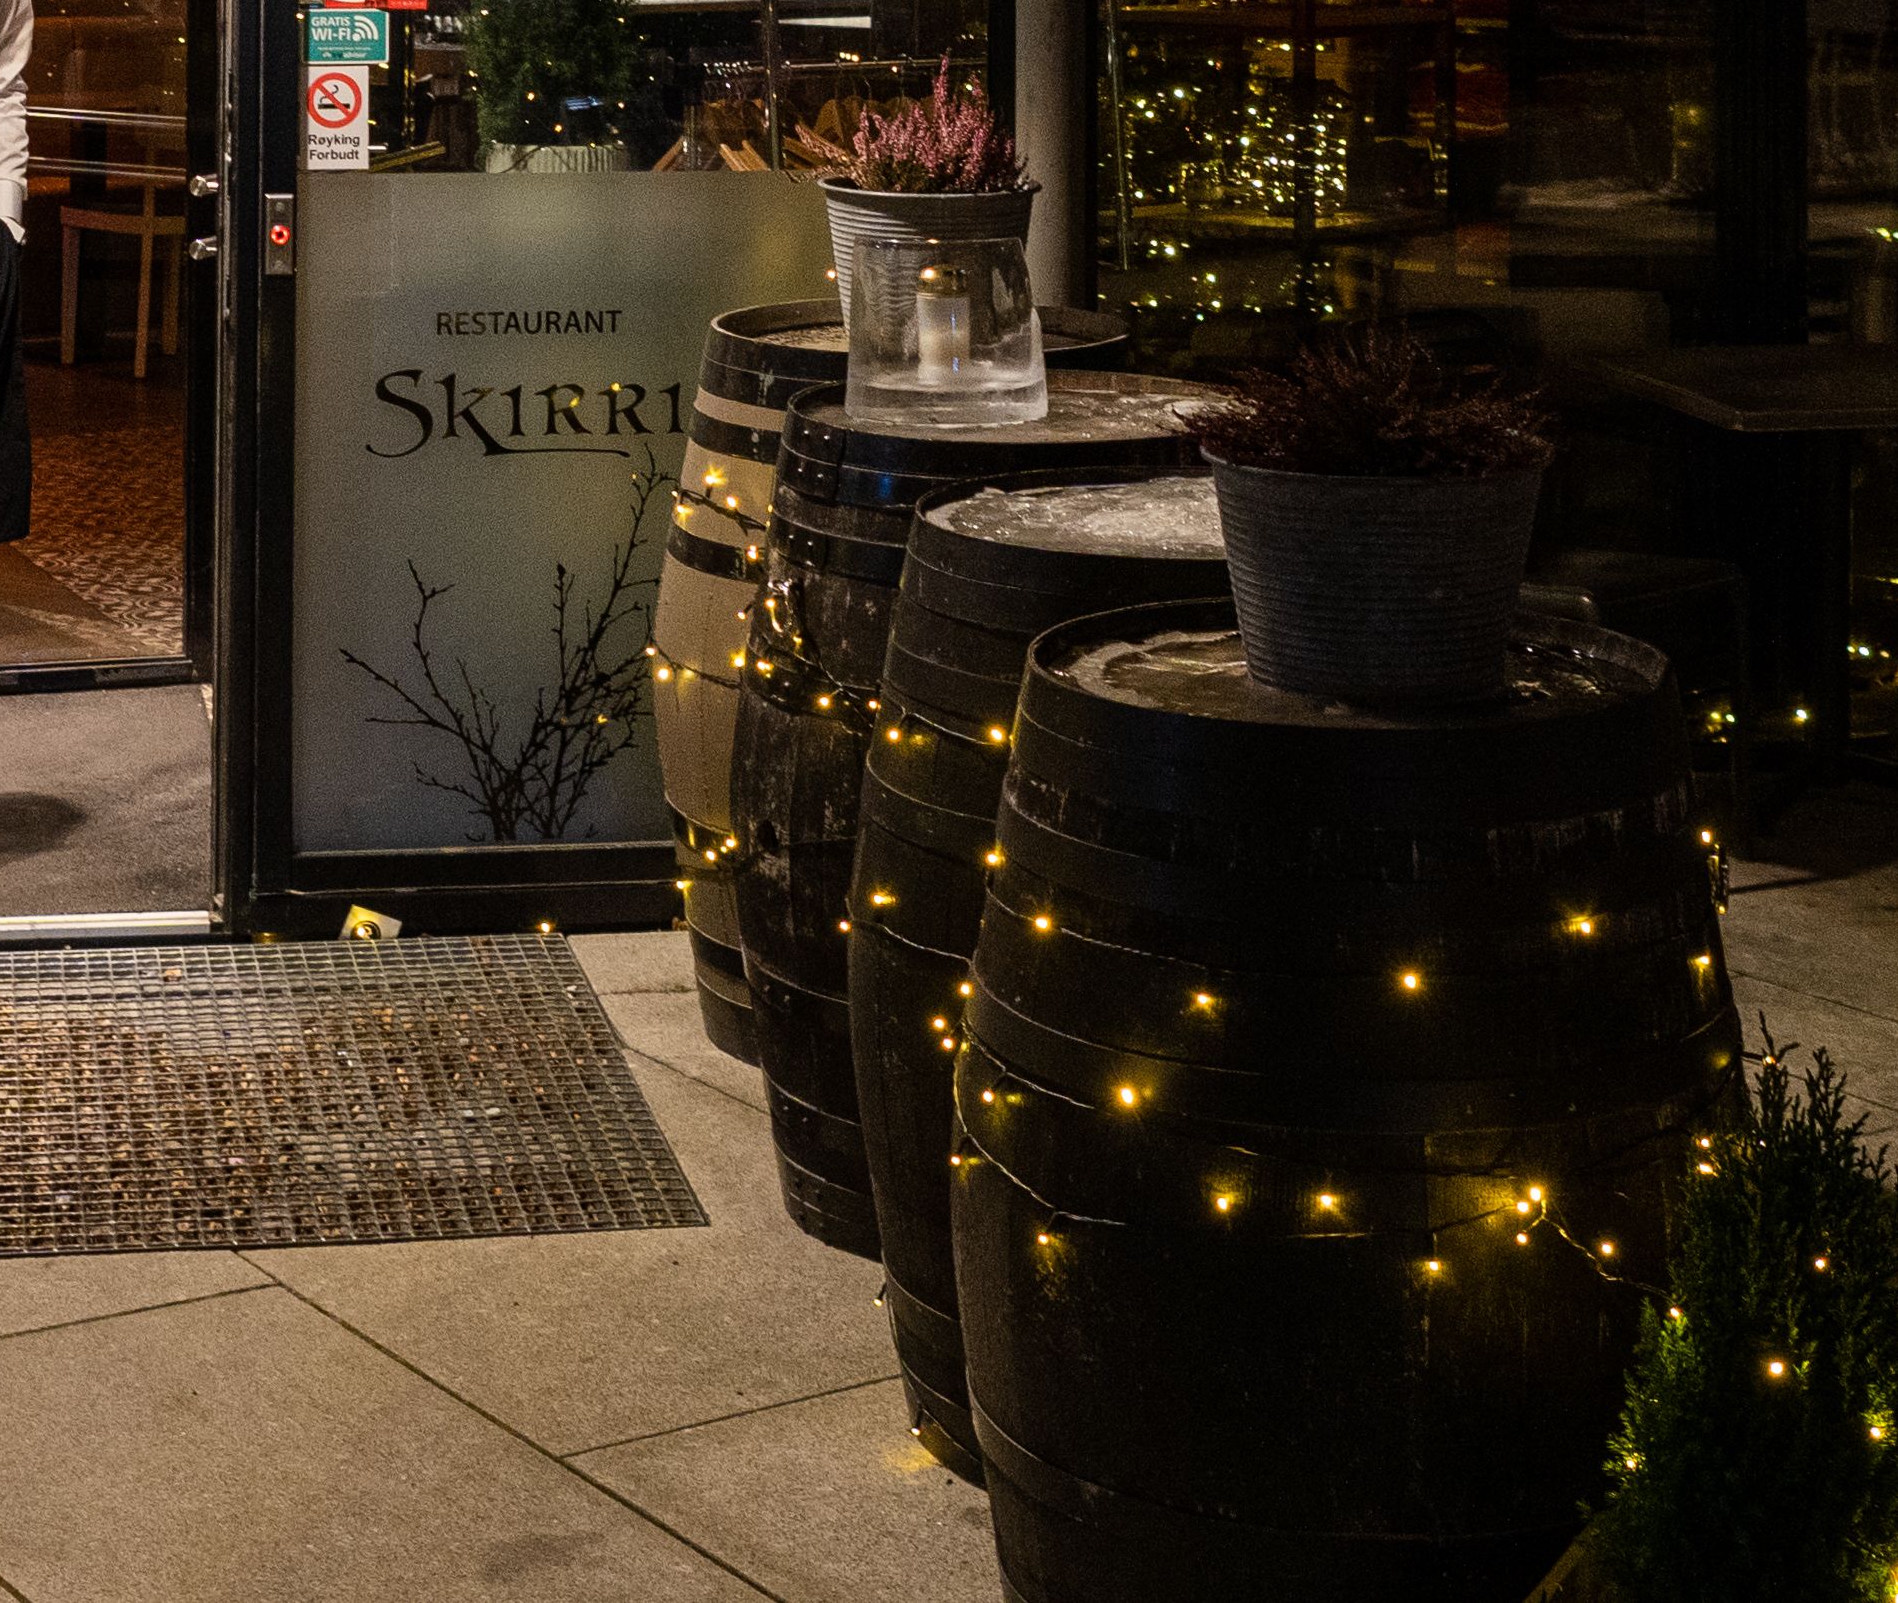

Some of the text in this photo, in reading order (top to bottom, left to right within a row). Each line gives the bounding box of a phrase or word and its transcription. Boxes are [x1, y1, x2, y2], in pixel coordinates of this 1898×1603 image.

[311, 16, 351, 28] GRATIS
[311, 27, 351, 41] WI-FI
[308, 134, 360, 148] Røyking
[309, 149, 359, 160] Forbudt
[436, 309, 623, 336] RESTAURANT
[365, 369, 686, 459] SKIRRI
